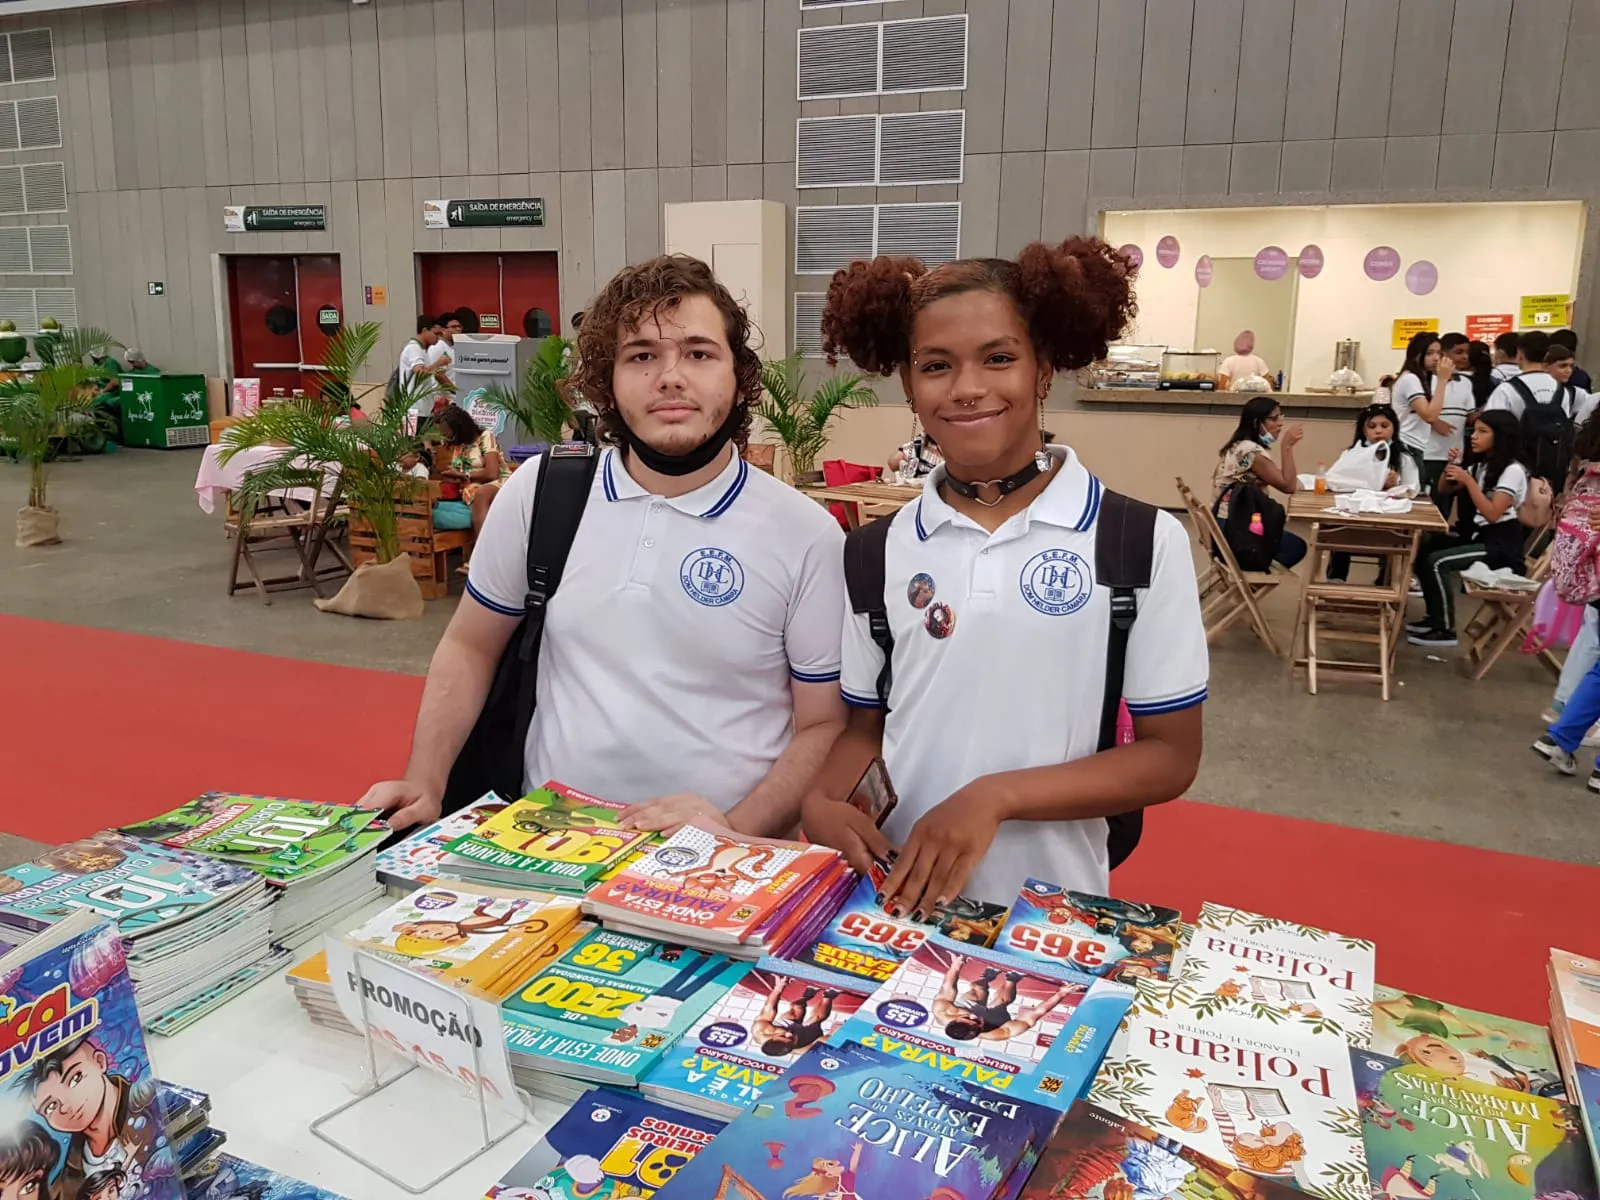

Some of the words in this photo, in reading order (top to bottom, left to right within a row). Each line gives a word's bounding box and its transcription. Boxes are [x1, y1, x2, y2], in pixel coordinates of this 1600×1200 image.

[262, 207, 278, 216] SAÍDA
[287, 207, 323, 216] EMERGÊNCIA
[469, 202, 488, 211] SAÍDA
[489, 203, 499, 211] DE
[499, 200, 541, 210] EMERGÊNCIA
[1023, 583, 1035, 600] DOM
[1031, 598, 1060, 613] HELDER
[166, 803, 250, 844] DINOSSAUROS
[188, 802, 287, 849] CURIOSIDADES
[230, 815, 330, 850] 101
[453, 841, 522, 866] PALAVRA
[530, 858, 545, 872] É
[545, 860, 588, 877] QUAL
[11, 857, 153, 910] CURIOSIDADES
[607, 889, 624, 897] A
[643, 880, 679, 892] GERAL
[680, 887, 730, 902] CULTURA
[614, 881, 727, 912] PALAVRA?
[630, 893, 667, 909] ESTÁ
[663, 903, 716, 920] ONDE
[837, 913, 926, 951] 365
[1232, 936, 1269, 949] PORTER
[594, 935, 647, 952] PALAVRAS
[1008, 925, 1107, 966] 365
[572, 943, 636, 972] 36
[816, 943, 896, 971] EAGUE
[1202, 936, 1357, 991] Poliana
[1287, 950, 1333, 964] ELEANOR
[520, 975, 645, 1019] 2500
[606, 980, 654, 993] PALAVRAS
[346, 971, 483, 1049] PROMOÇÃO
[884, 1010, 920, 1026] 155
[502, 1026, 545, 1048] PALA
[543, 1035, 557, 1050] A
[705, 1030, 739, 1045] 155
[878, 1026, 952, 1054] VOCABULÁRIO
[1176, 1023, 1223, 1040] PORTER
[1227, 1035, 1241, 1044] H.
[561, 1037, 596, 1059] ESTÁ
[594, 1046, 641, 1068] ONDE
[700, 1047, 765, 1071] VOCABULÁRIO
[1244, 1038, 1301, 1058] ELEANOR
[681, 1055, 775, 1087] AVRA?
[861, 1032, 1014, 1089] PALAVRA?
[1144, 1026, 1337, 1099] Poliana
[686, 1070, 707, 1083] A
[707, 1076, 729, 1095] É
[698, 1087, 752, 1106] NAQUE
[872, 1101, 889, 1113] DO
[1392, 1072, 1542, 1120] MARAVILHAS
[858, 1077, 993, 1138] ESPELHO
[640, 1117, 715, 1146] senhos
[894, 1110, 959, 1138] ATRAVÉS
[1088, 1112, 1126, 1133] Lafonte
[1402, 1094, 1534, 1154] ALICE
[626, 1127, 705, 1156] MEIROS
[833, 1103, 978, 1178] ALICE
